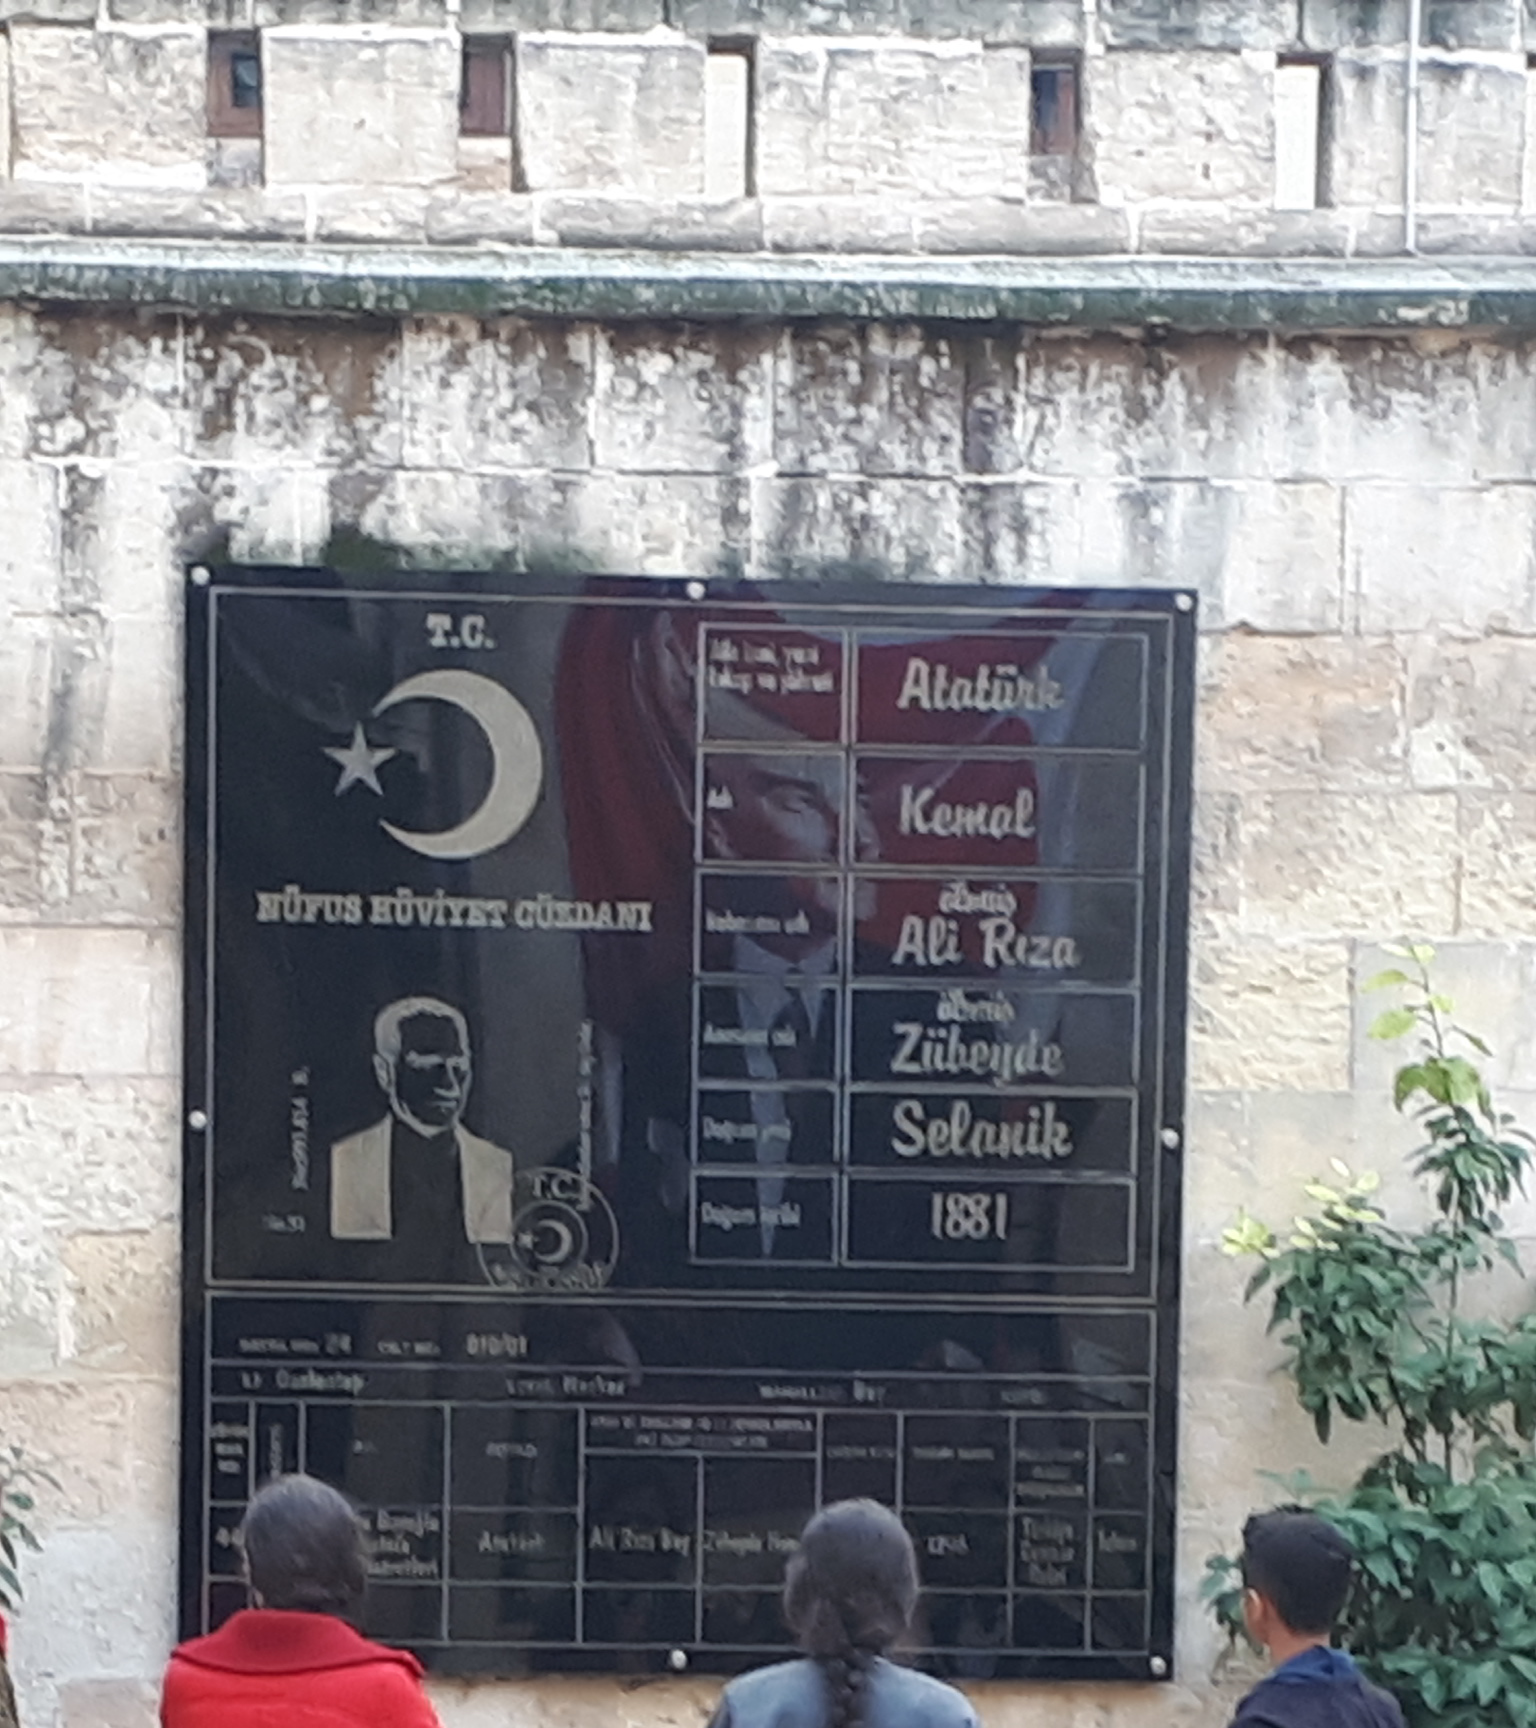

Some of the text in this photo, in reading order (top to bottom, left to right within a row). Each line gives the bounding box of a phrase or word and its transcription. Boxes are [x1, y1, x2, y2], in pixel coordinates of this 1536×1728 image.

[426, 612, 498, 650] T.C.
[895, 656, 1066, 713] Atatürk
[897, 783, 1037, 841] Kemal
[255, 883, 363, 925] NÜFUS
[370, 886, 508, 929] HÜVİYET
[891, 914, 1083, 969] Ali Rıza
[890, 1021, 1066, 1087] Zübeyde
[891, 1098, 1074, 1162] Selanik
[931, 1191, 1010, 1241] 1881
